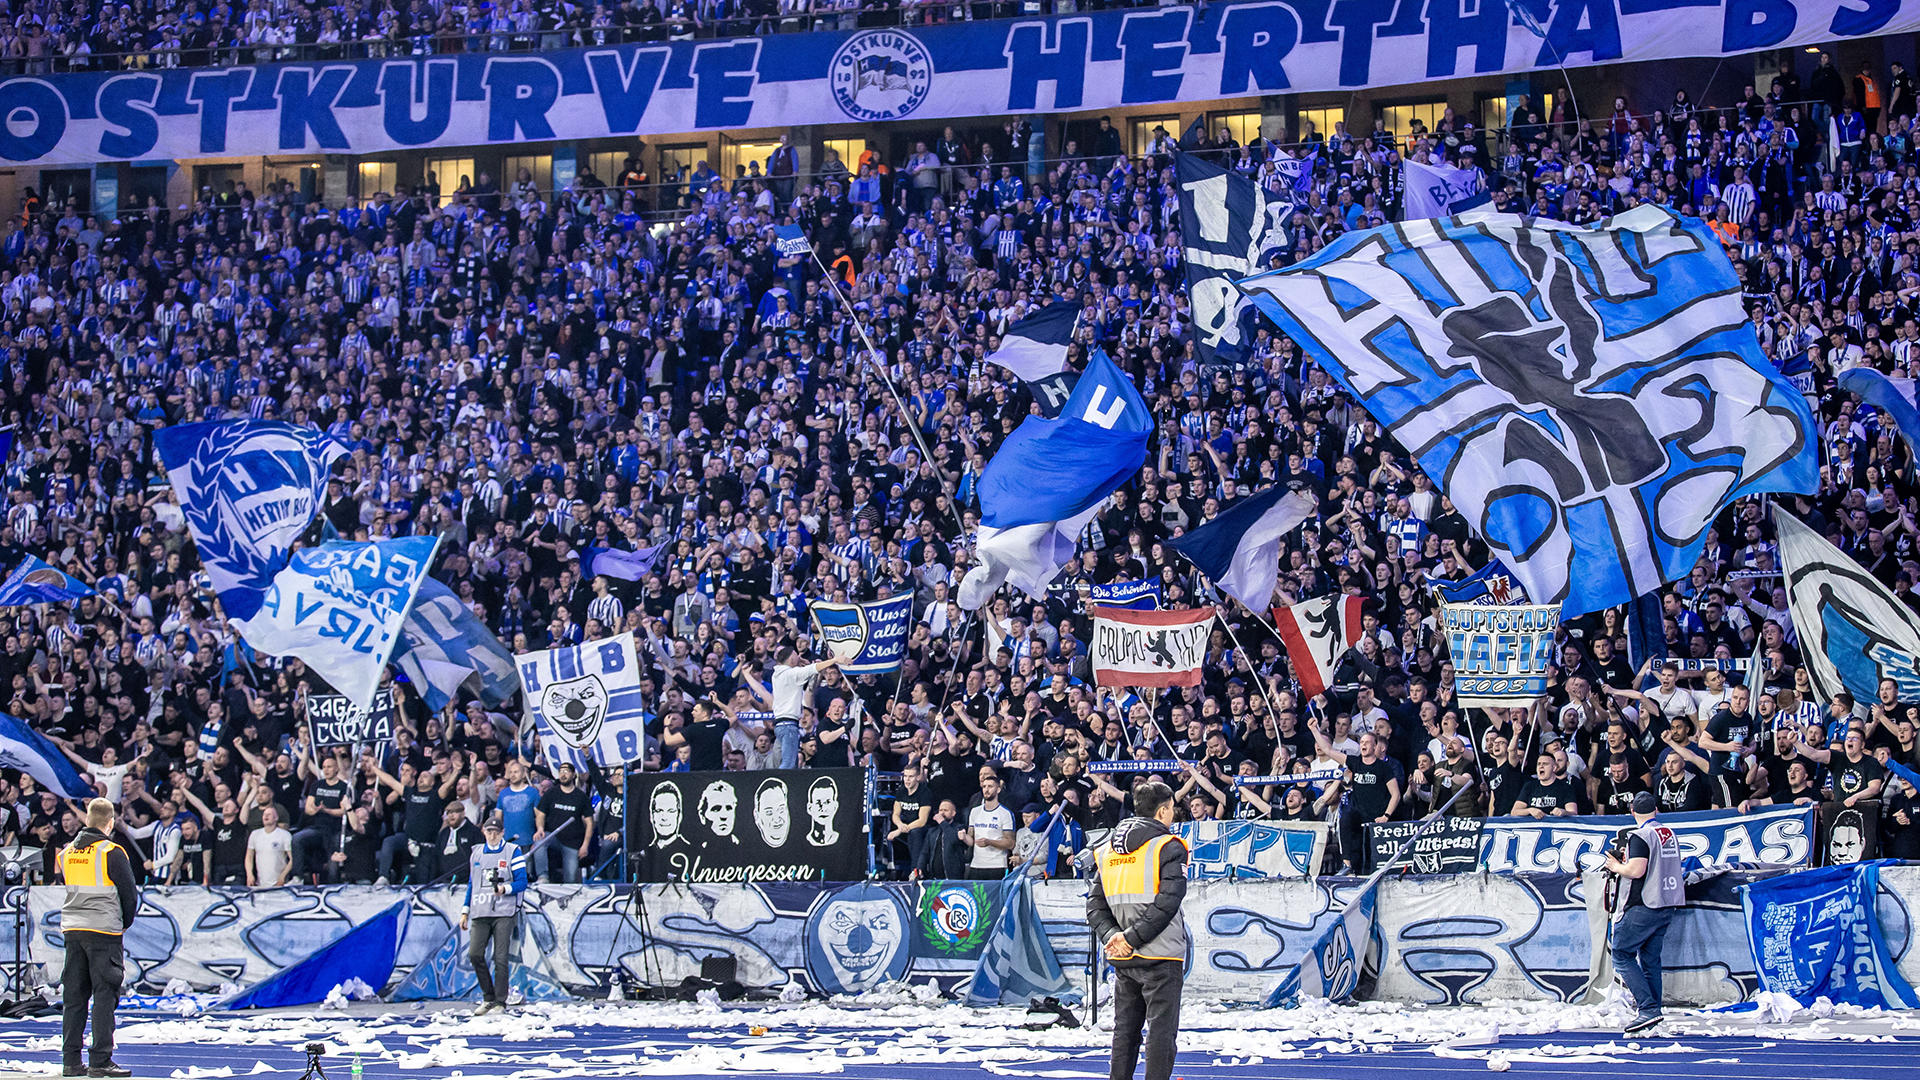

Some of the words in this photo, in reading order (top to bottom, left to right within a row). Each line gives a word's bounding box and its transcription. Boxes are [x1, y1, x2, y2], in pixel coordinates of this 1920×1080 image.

[840, 34, 923, 66] OSTKURVE
[1003, 0, 1624, 111] HERTHA
[837, 73, 851, 82] 18
[910, 70, 925, 79] 92
[0, 39, 762, 162] OSTKURVE
[836, 87, 895, 119] HERTHA
[897, 85, 925, 115] BSC
[869, 608, 909, 622] Unse
[873, 623, 907, 639] alle
[866, 642, 905, 658] Stol
[1652, 660, 1769, 668] BRLIN
[1460, 679, 1527, 693] 2003
[308, 688, 394, 717] RAGAZI
[1449, 817, 1480, 832] für
[670, 853, 815, 883] Unvergessen
[1110, 857, 1136, 866] STEWARD
[1663, 876, 1677, 890] 19
